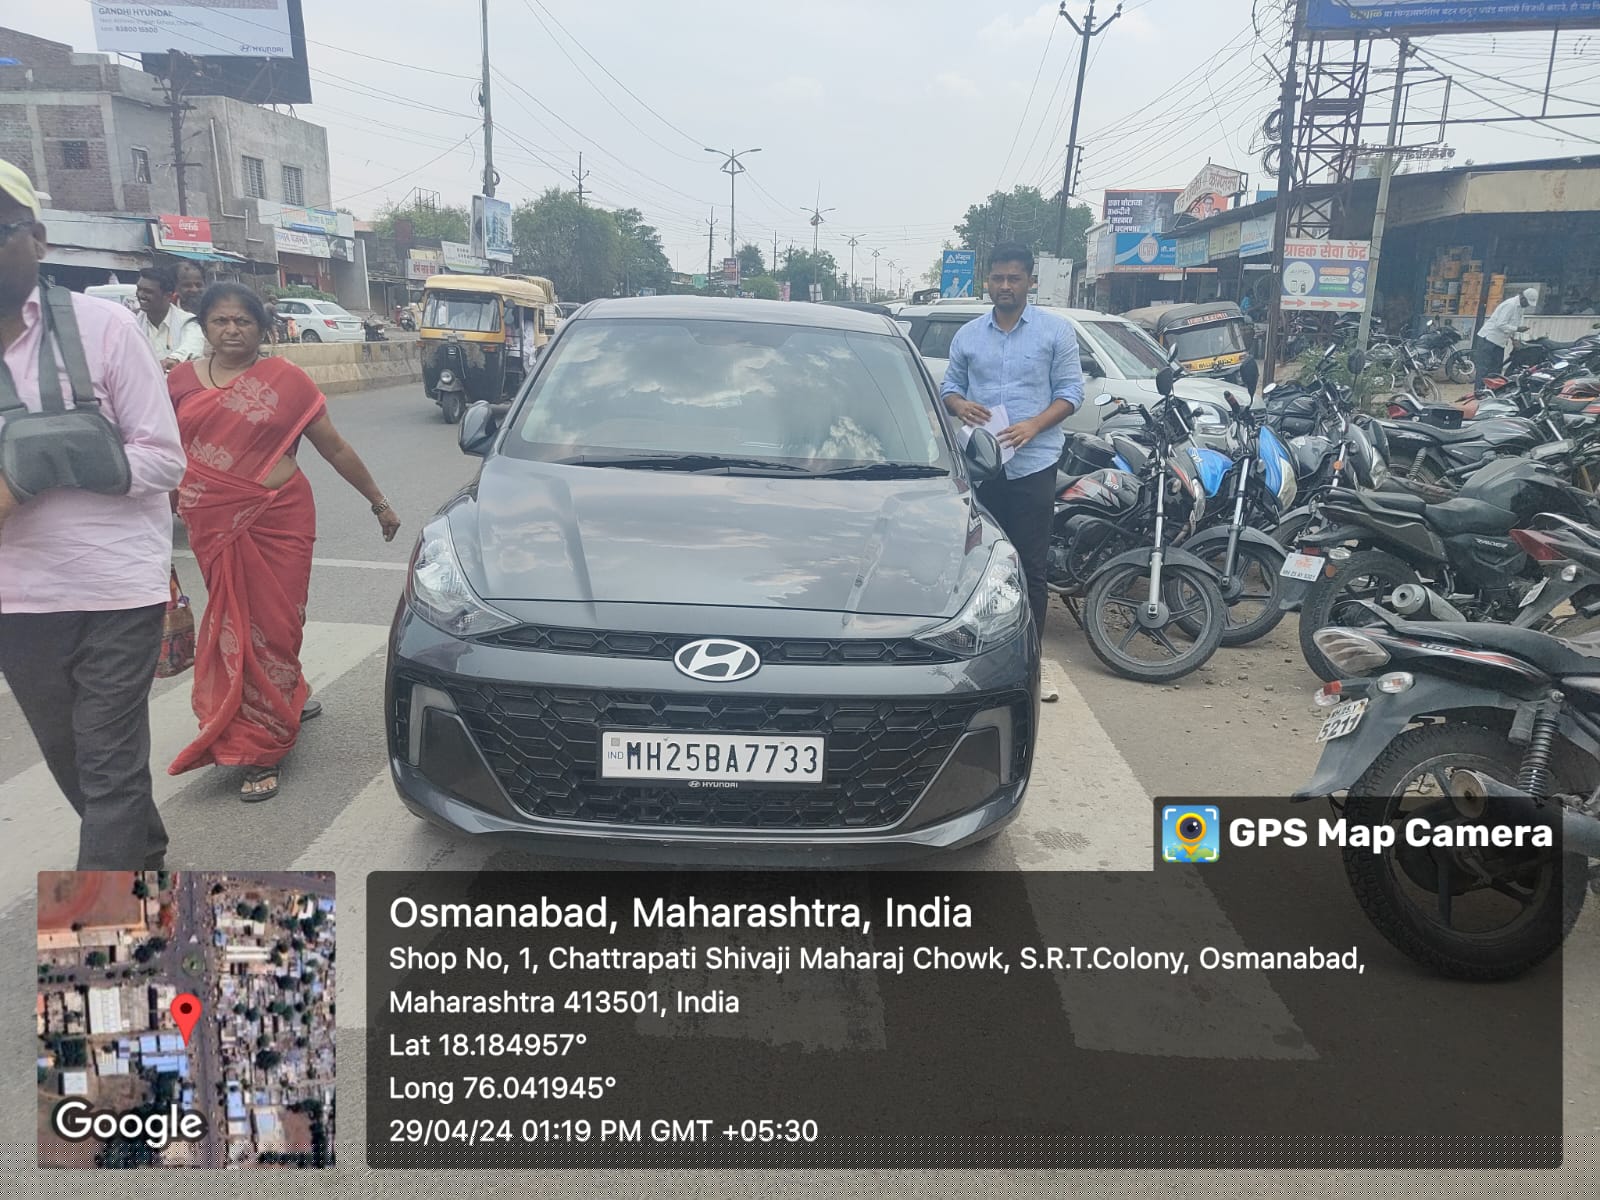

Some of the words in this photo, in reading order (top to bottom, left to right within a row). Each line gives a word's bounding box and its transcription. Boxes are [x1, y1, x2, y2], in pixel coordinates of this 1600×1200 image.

[99, 7, 131, 16] GANDHI
[132, 8, 173, 17] HYUNDAI
[1284, 243, 1318, 257] ग्राहक
[1319, 241, 1345, 258] सेवा
[1318, 713, 1360, 741] 5211
[607, 751, 624, 760] IND
[626, 741, 818, 774] MH25BA7733
